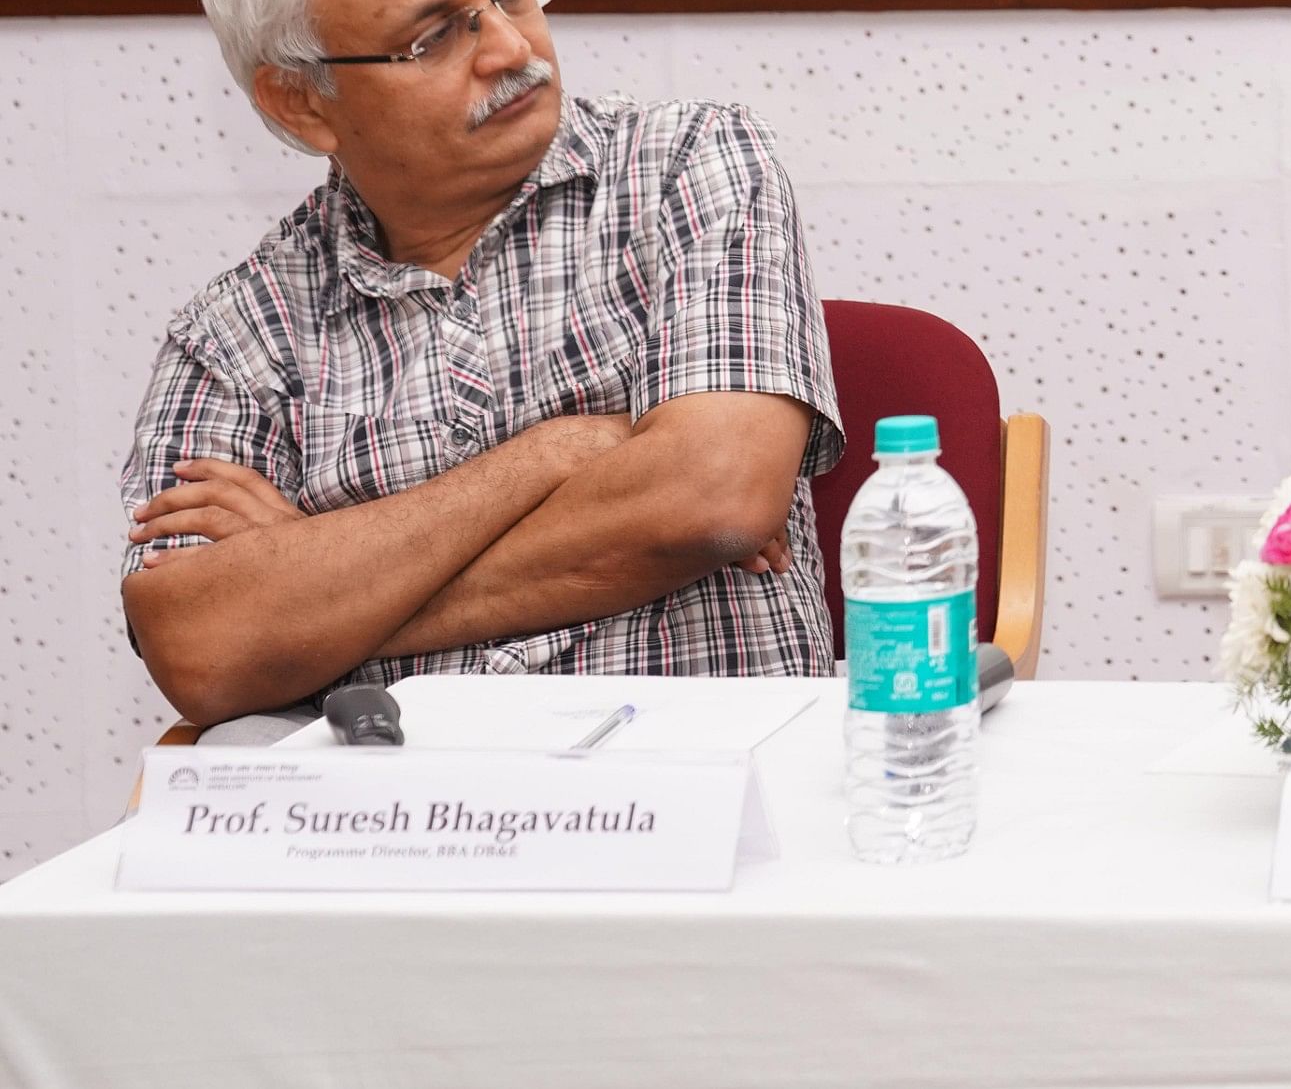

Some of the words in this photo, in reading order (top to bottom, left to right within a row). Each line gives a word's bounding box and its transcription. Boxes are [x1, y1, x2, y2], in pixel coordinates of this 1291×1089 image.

[182, 801, 271, 835] Prof.
[283, 800, 410, 835] Suresh
[425, 800, 657, 843] Bhagavatula
[286, 845, 367, 860] Programme
[371, 844, 431, 859] Director,
[436, 845, 469, 858] BBA
